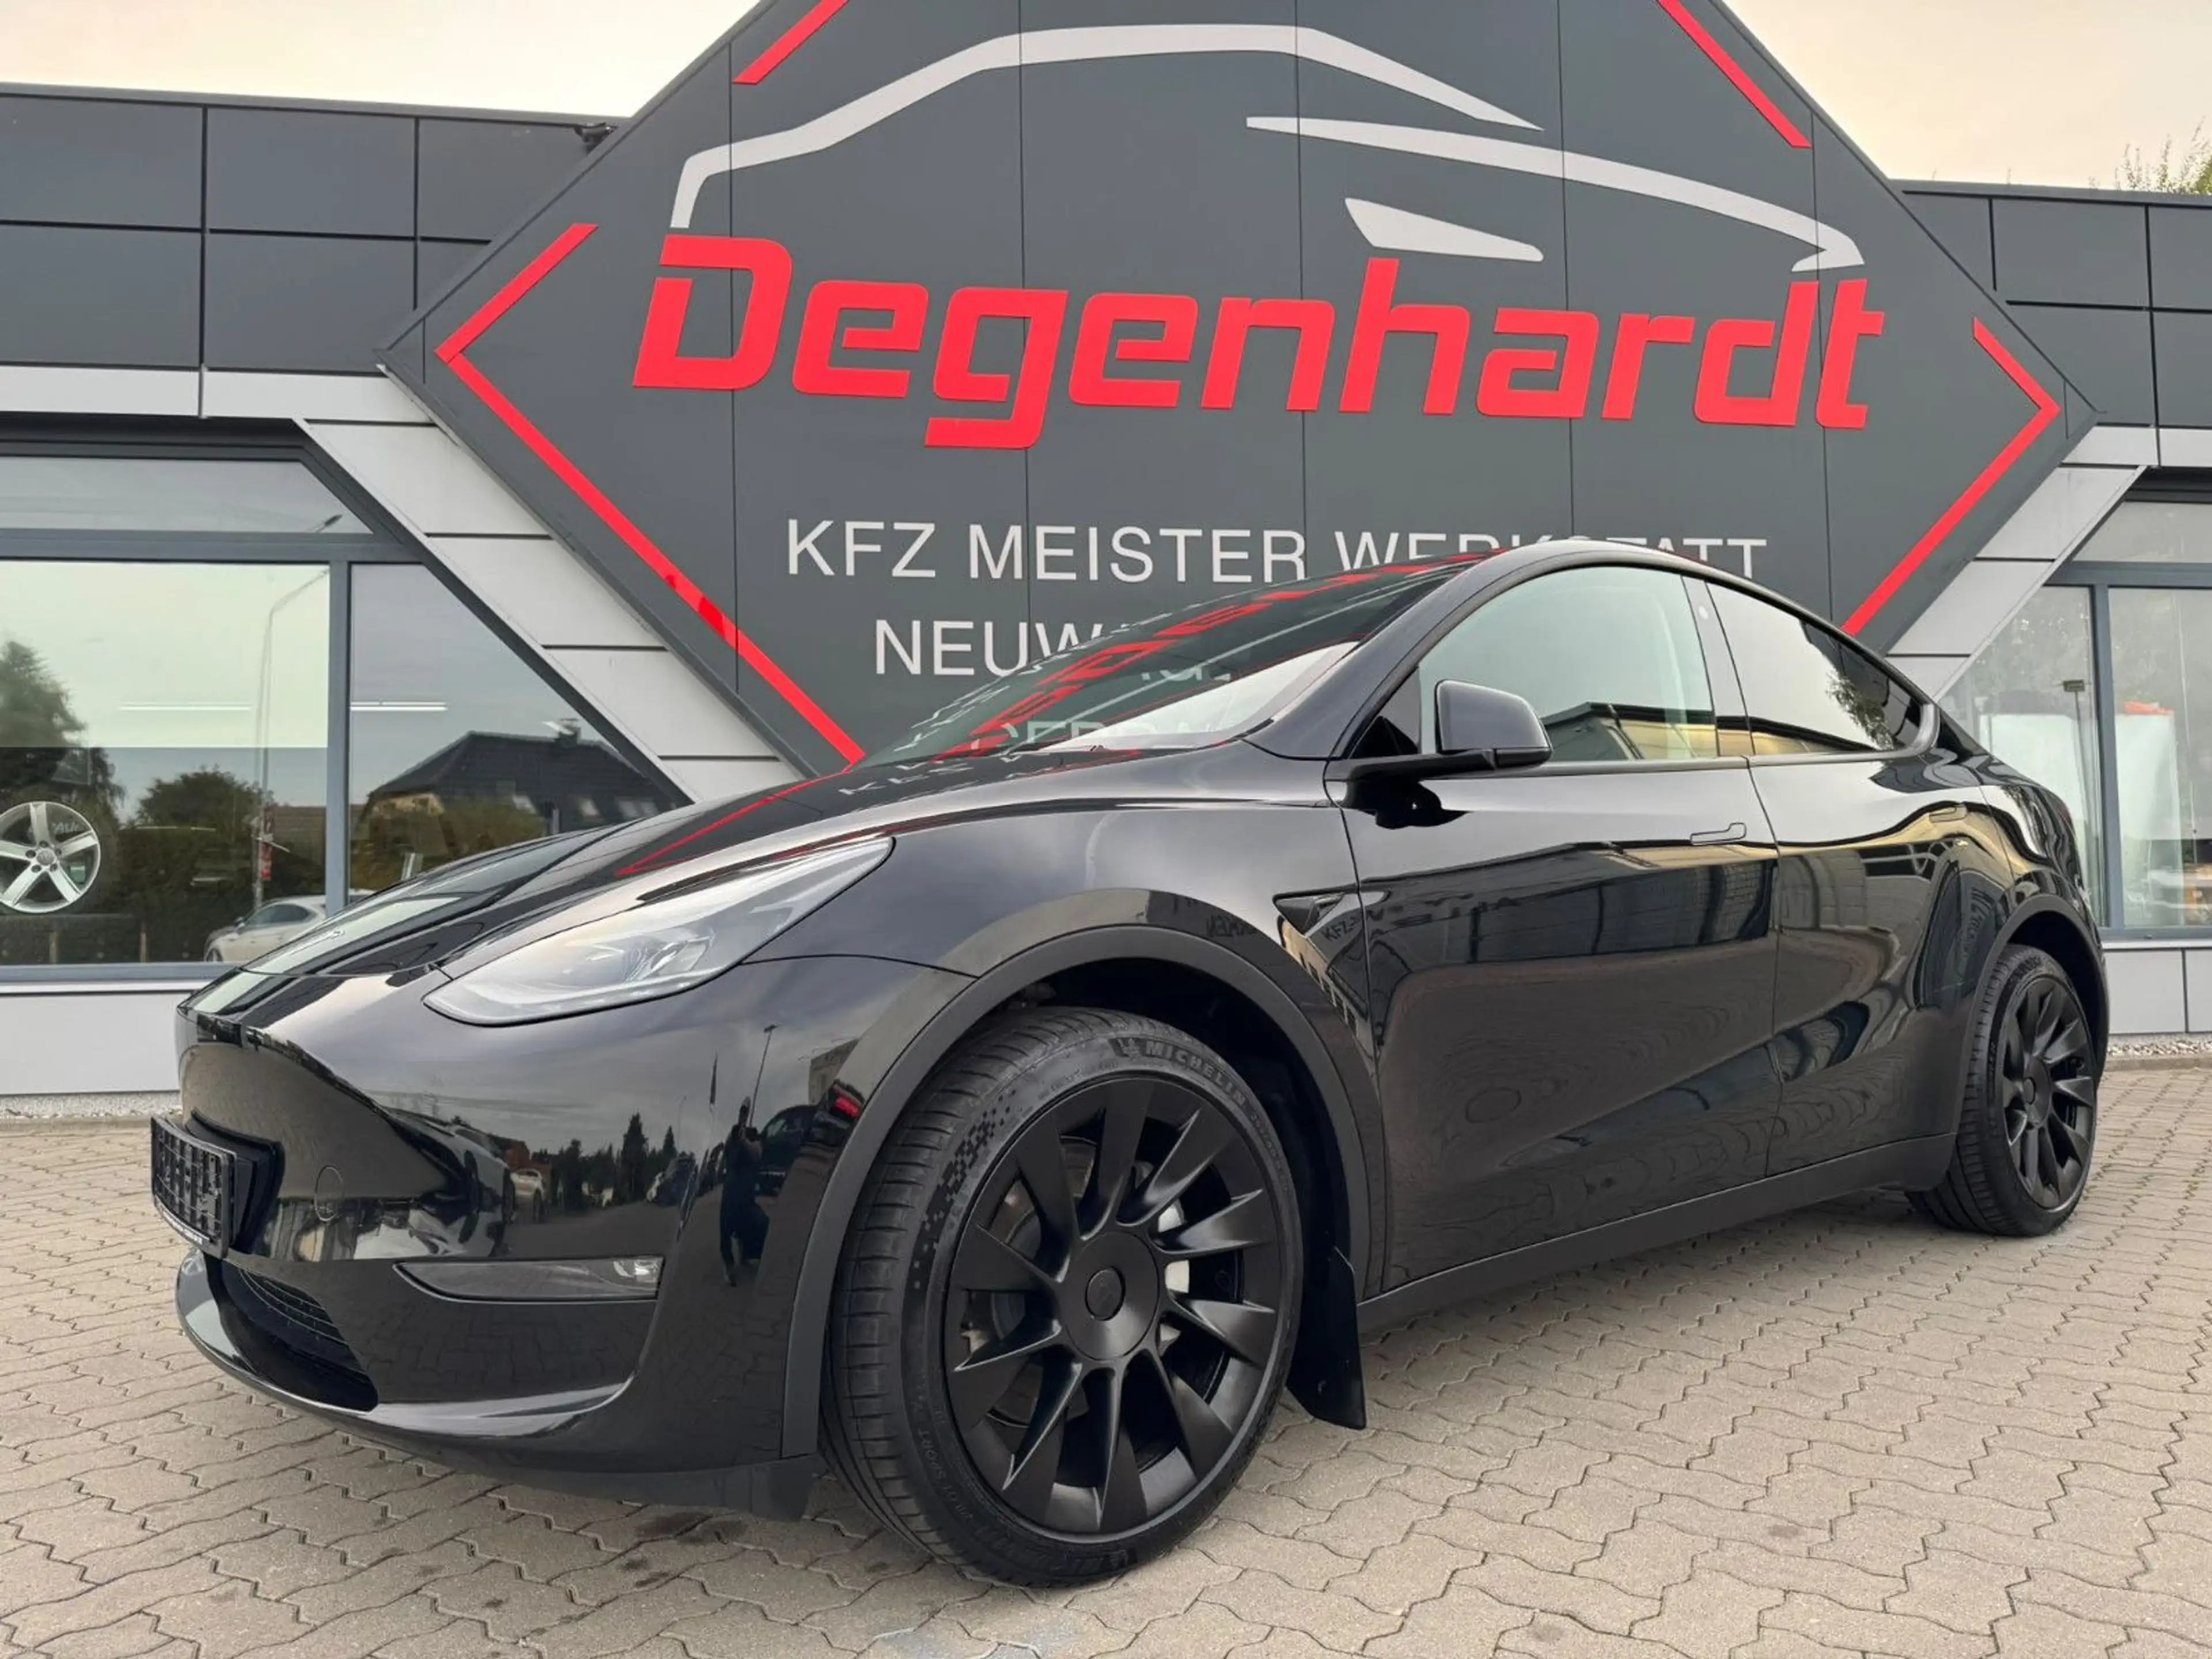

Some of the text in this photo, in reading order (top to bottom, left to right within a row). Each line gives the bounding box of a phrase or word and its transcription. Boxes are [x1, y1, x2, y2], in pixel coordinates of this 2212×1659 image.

[632, 234, 1884, 449] Degenhardt
[787, 519, 936, 576] KFZ
[969, 524, 1308, 583] MEISTER
[1145, 1040, 1246, 1106] MICHELIN
